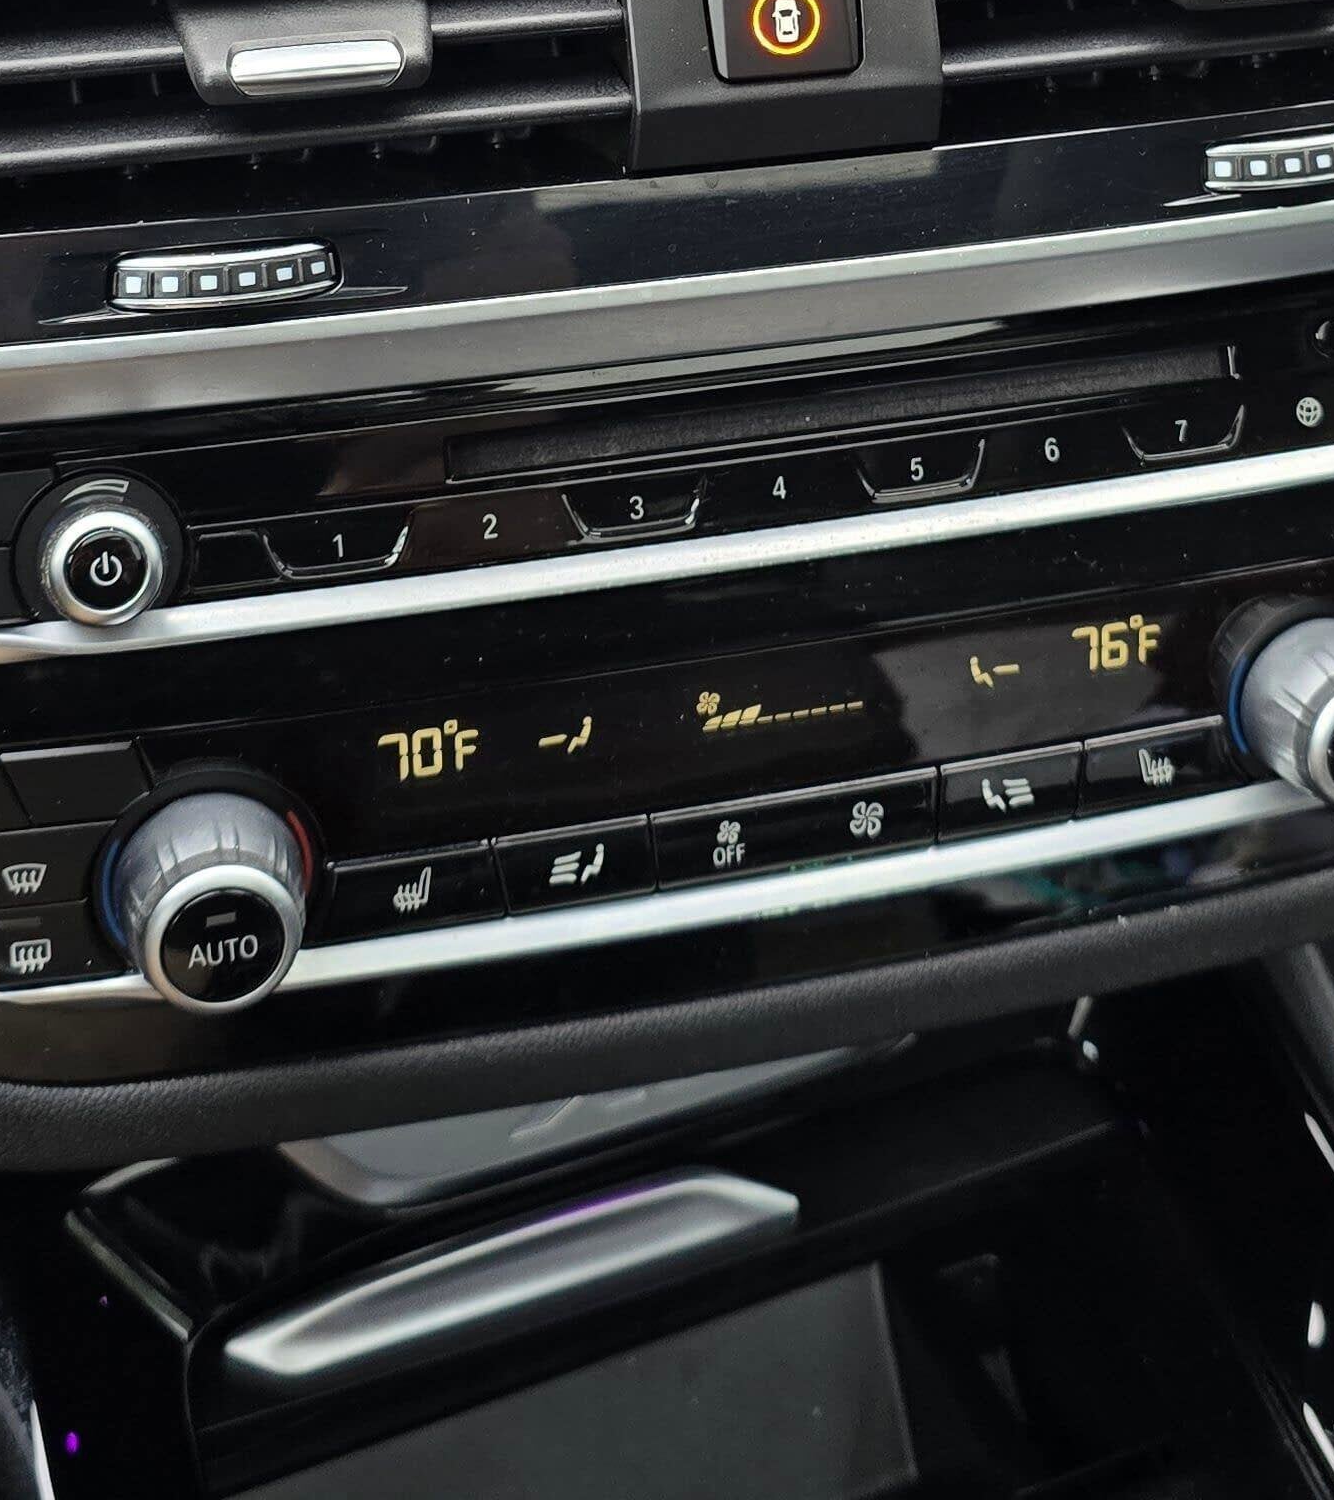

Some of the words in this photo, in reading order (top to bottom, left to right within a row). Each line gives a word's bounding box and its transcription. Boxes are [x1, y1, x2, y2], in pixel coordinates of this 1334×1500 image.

[1174, 419, 1188, 443] 7
[1043, 436, 1061, 463] 6
[909, 456, 925, 482] 5
[771, 475, 787, 500] 4
[627, 495, 646, 521] 3
[481, 513, 500, 541] 2
[332, 532, 345, 558] 1
[1071, 613, 1162, 672] 76°F
[376, 718, 480, 783] 70°F
[712, 843, 746, 869] OFF
[187, 933, 260, 970] AUTO
